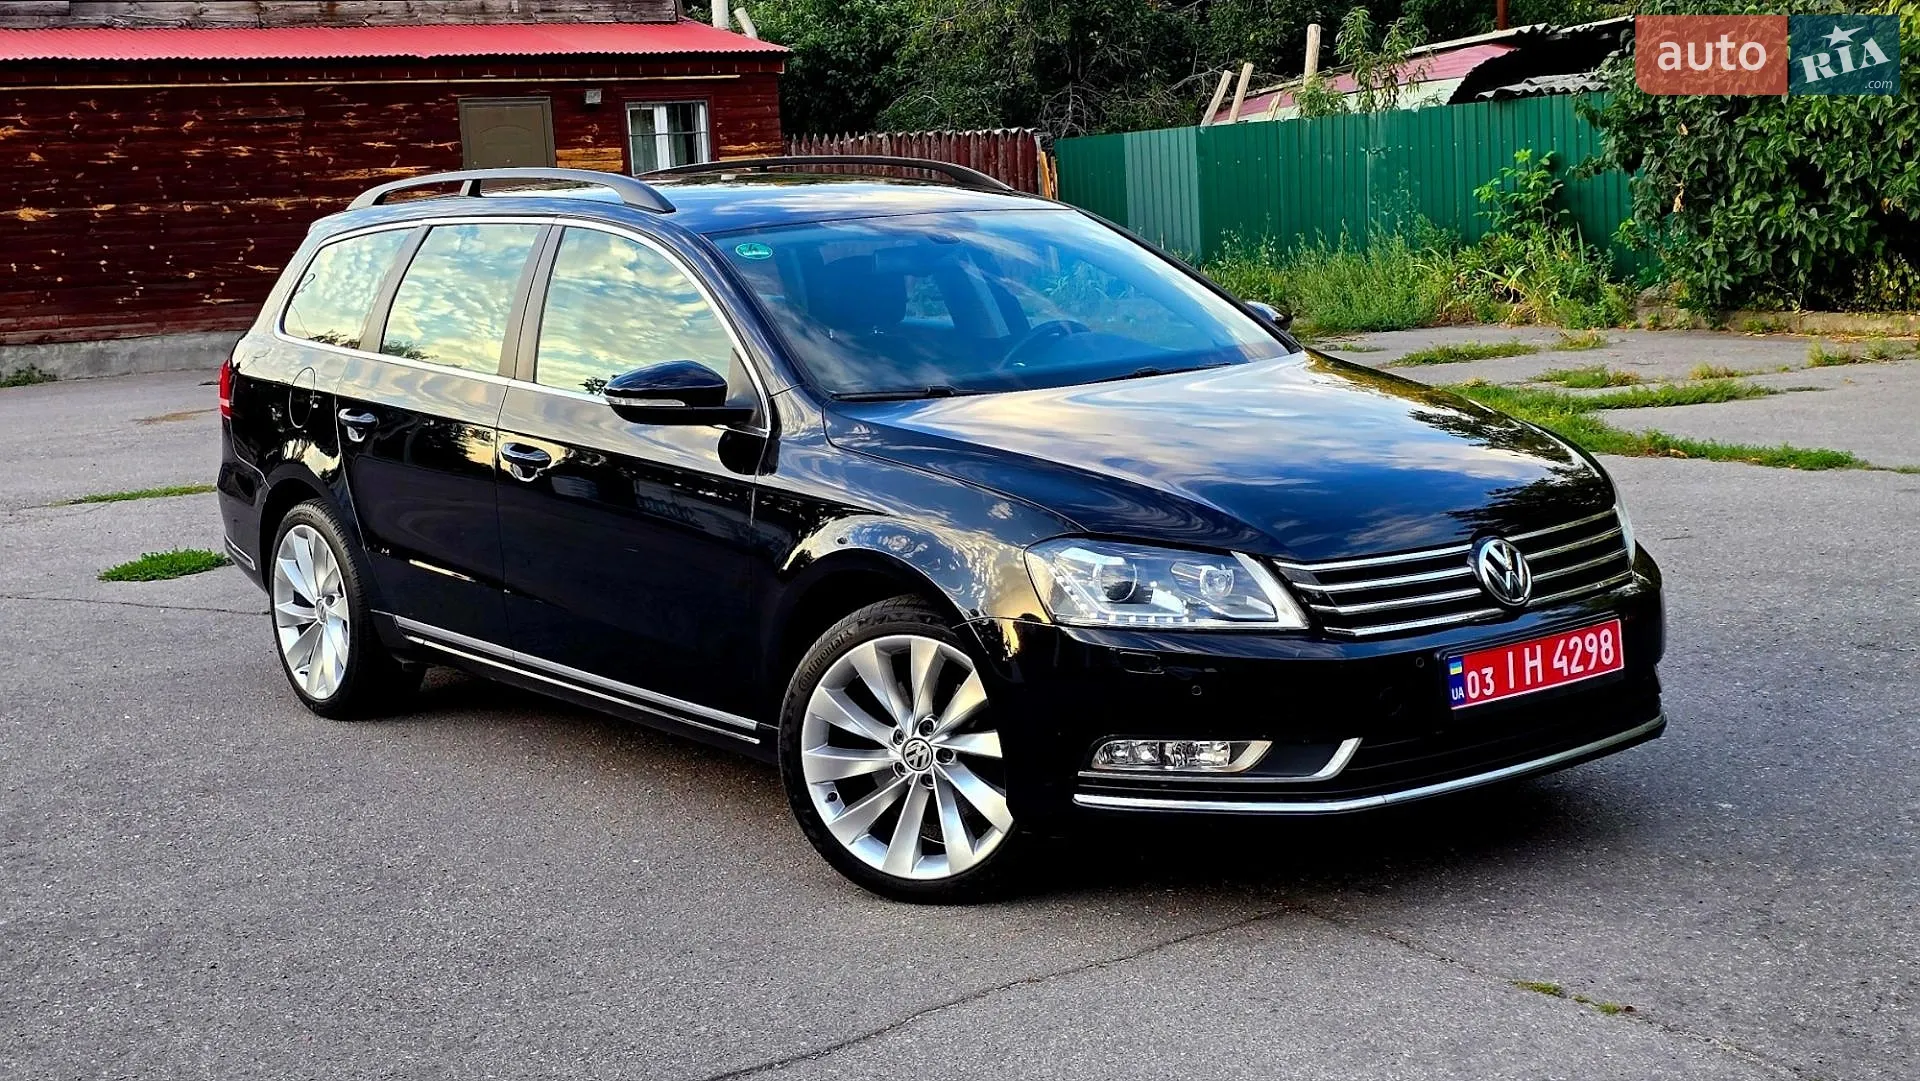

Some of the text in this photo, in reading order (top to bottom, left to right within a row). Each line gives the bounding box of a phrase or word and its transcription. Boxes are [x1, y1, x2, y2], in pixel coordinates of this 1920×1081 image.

[799, 633, 847, 691] Continental
[1467, 666, 1495, 699] 03
[1553, 628, 1614, 677] 4298
[1451, 686, 1465, 700] UA
